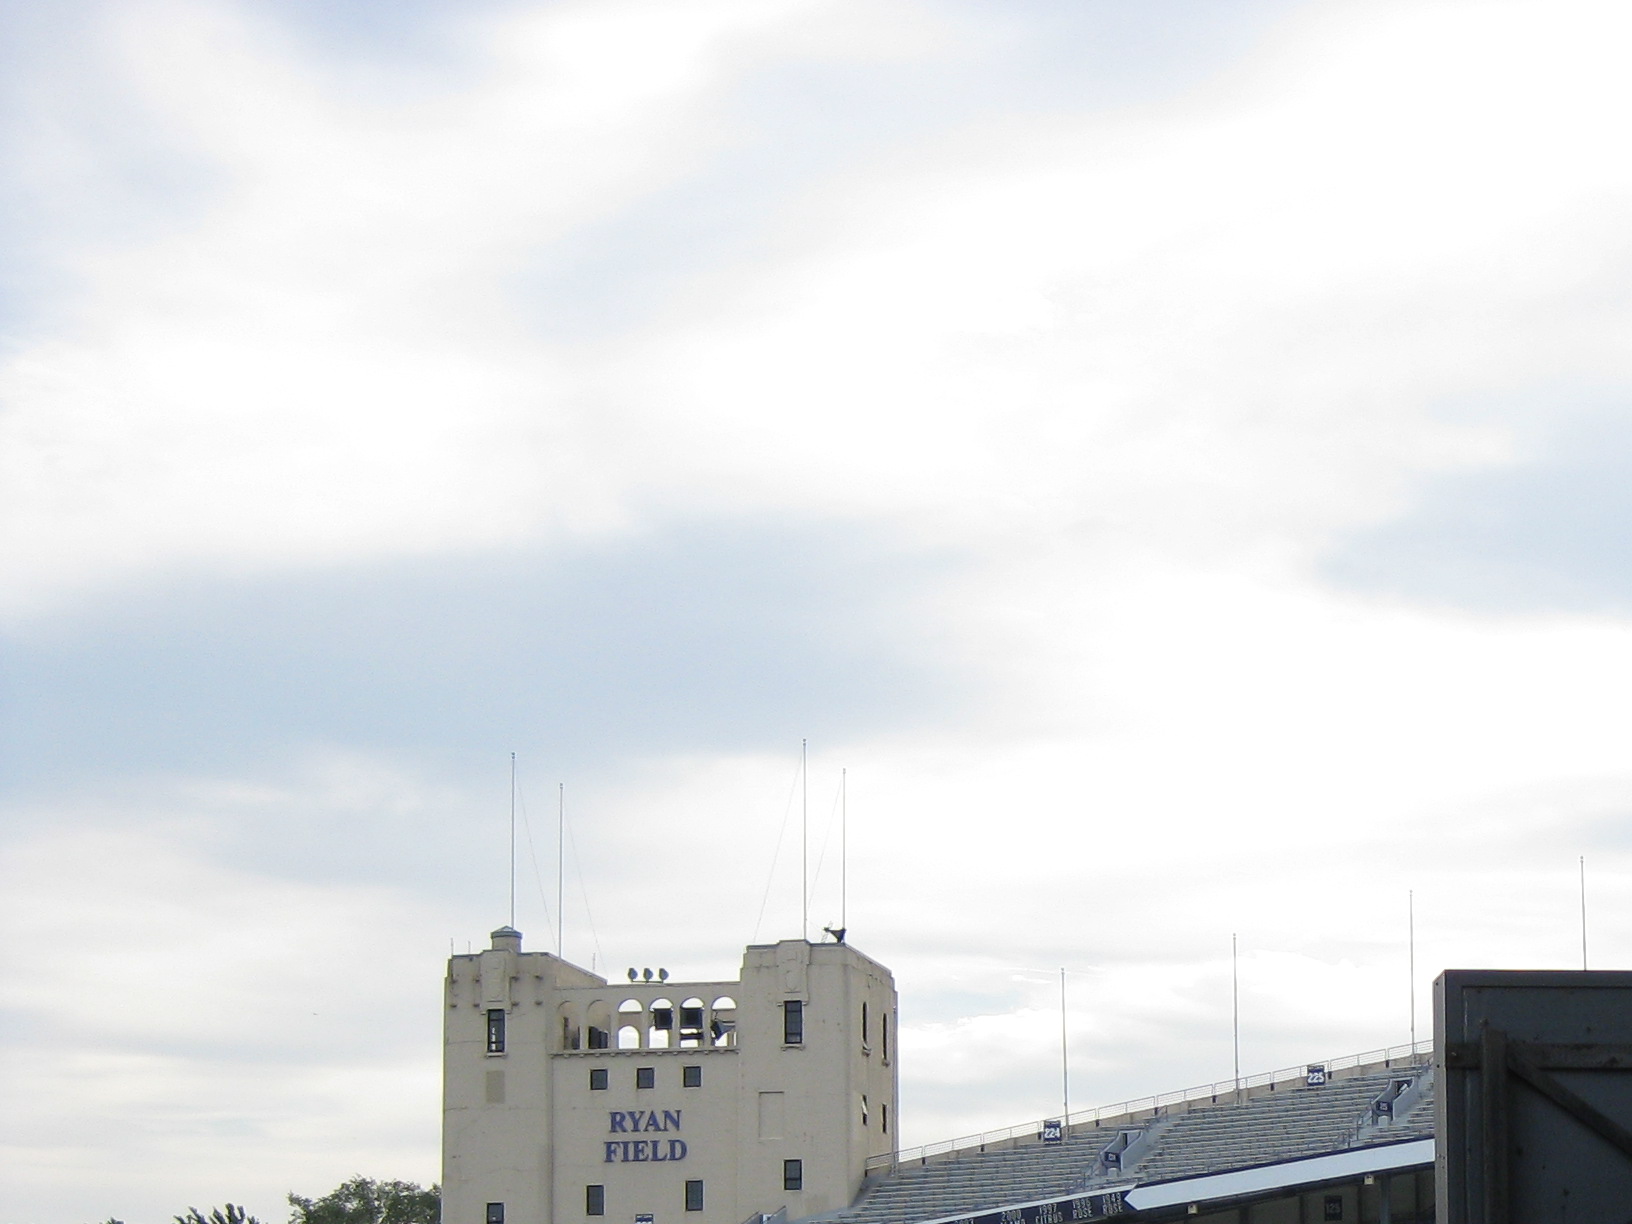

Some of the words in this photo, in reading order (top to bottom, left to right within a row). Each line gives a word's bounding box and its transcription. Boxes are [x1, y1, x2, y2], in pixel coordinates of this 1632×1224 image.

[1307, 1071, 1324, 1083] 225
[608, 1109, 682, 1133] RYAN
[1044, 1127, 1061, 1139] 224
[603, 1139, 688, 1163] FIELD
[1039, 1203, 1057, 1215] 1997
[1072, 1207, 1093, 1219] ROSE
